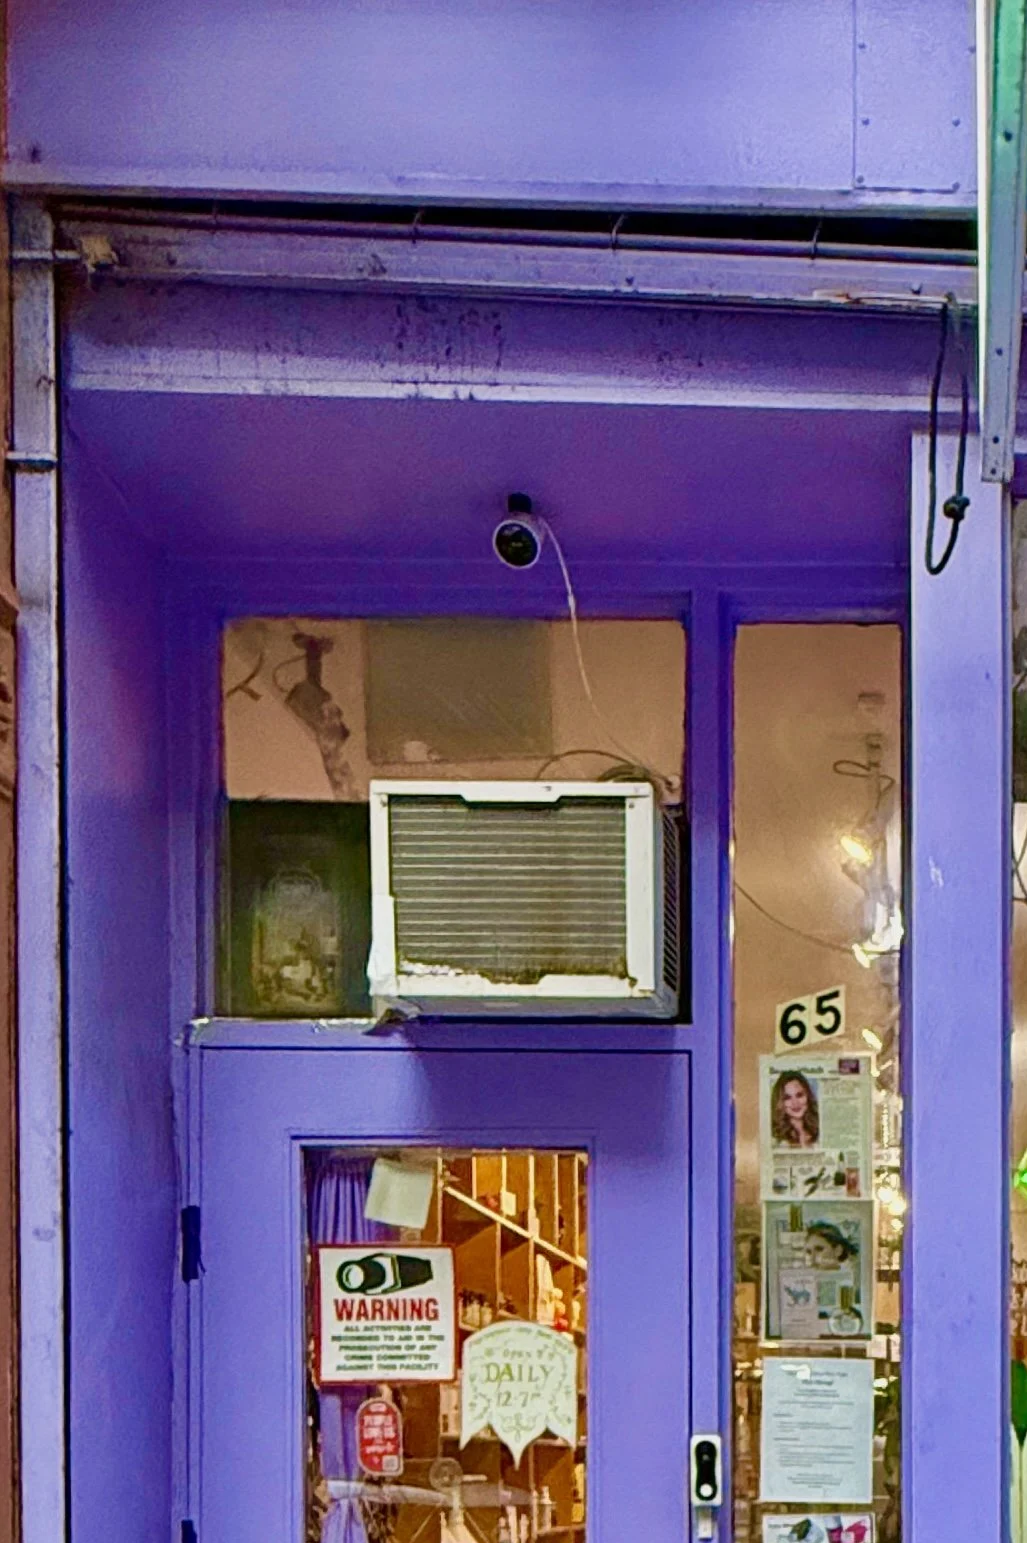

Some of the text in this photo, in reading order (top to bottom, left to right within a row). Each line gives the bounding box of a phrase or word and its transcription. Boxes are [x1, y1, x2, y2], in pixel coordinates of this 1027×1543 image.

[780, 990, 841, 1045] 65
[334, 1298, 439, 1321] WARNING
[482, 1362, 554, 1383] DAILY
